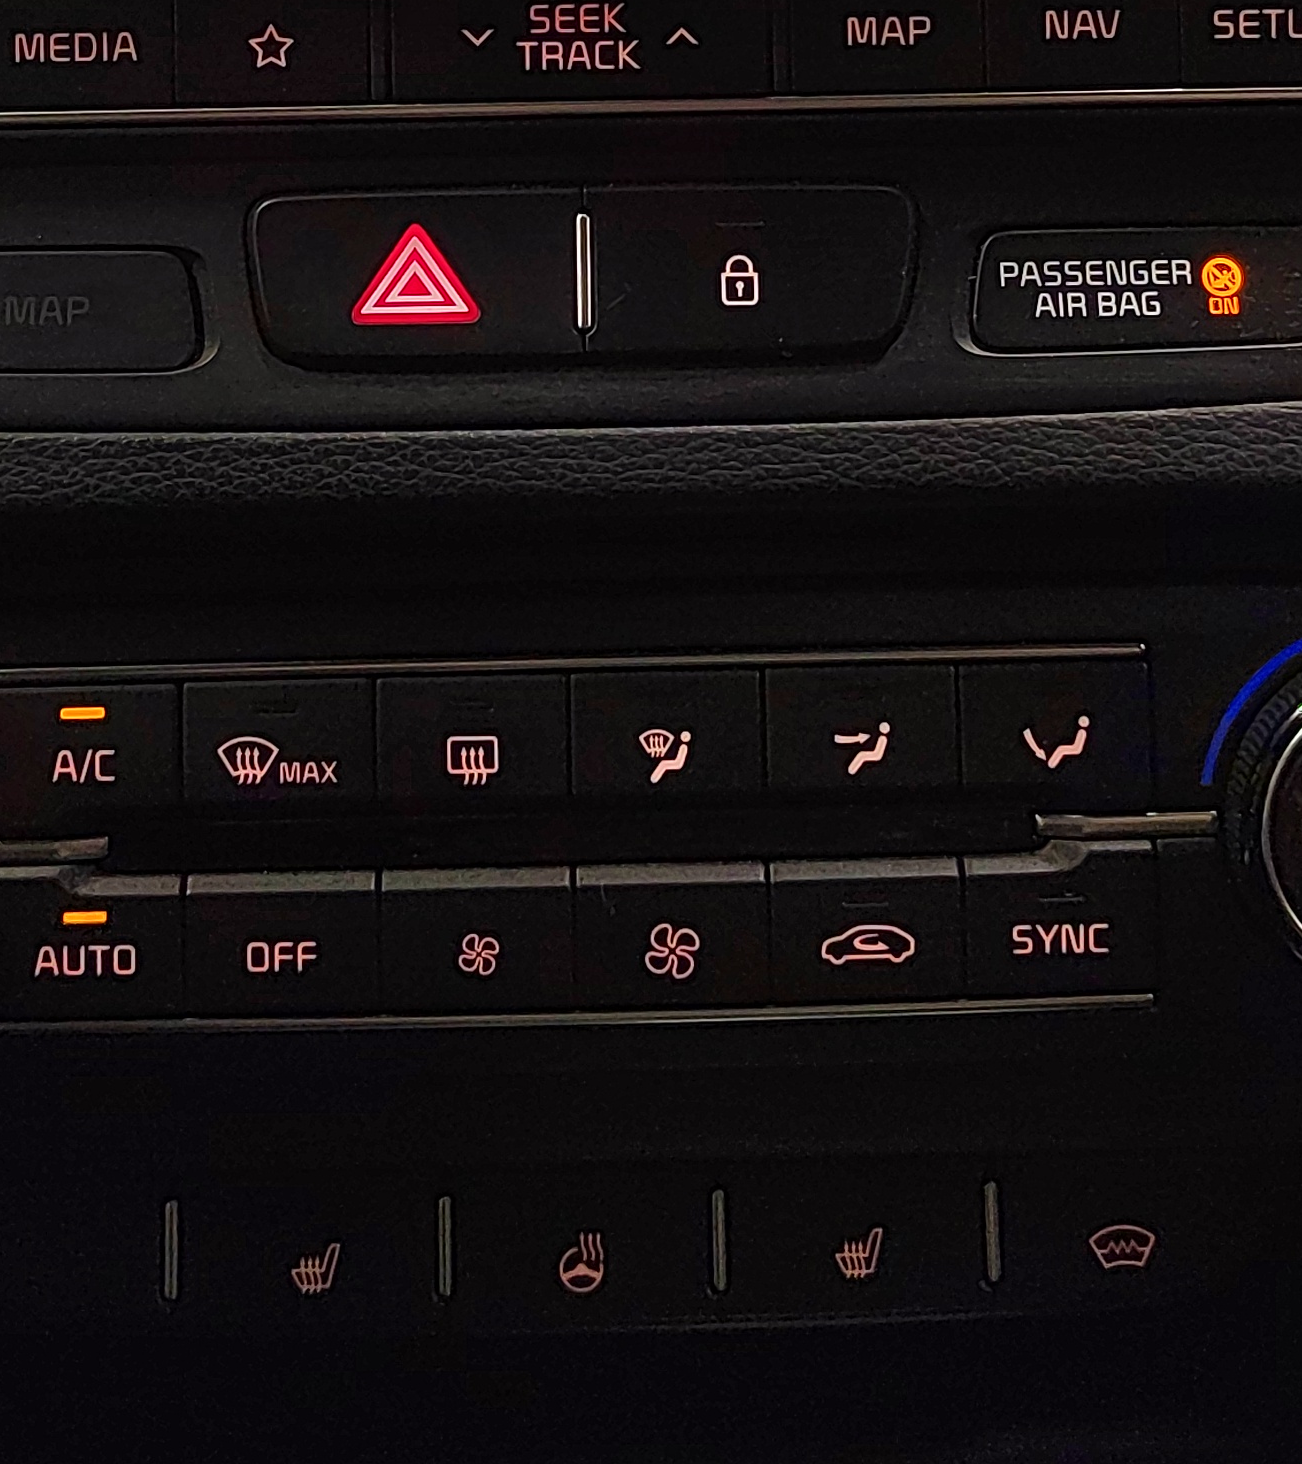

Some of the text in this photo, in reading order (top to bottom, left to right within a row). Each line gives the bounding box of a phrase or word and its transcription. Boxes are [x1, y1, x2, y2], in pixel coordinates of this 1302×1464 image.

[529, 3, 627, 34] SEEK
[846, 15, 932, 46] MAP
[1045, 9, 1121, 40] NAV
[14, 31, 138, 63] MEDIA
[515, 39, 642, 71] TRACK
[999, 259, 1193, 287] PASSENGER
[4, 295, 91, 326] MAP
[1035, 290, 1161, 318] AIR BAG
[1208, 296, 1241, 316] ON
[52, 748, 116, 785] A/C
[279, 760, 339, 785] MAX
[1011, 922, 1110, 955] SYNC
[34, 943, 137, 978] AUTO
[245, 940, 318, 974] OFF
